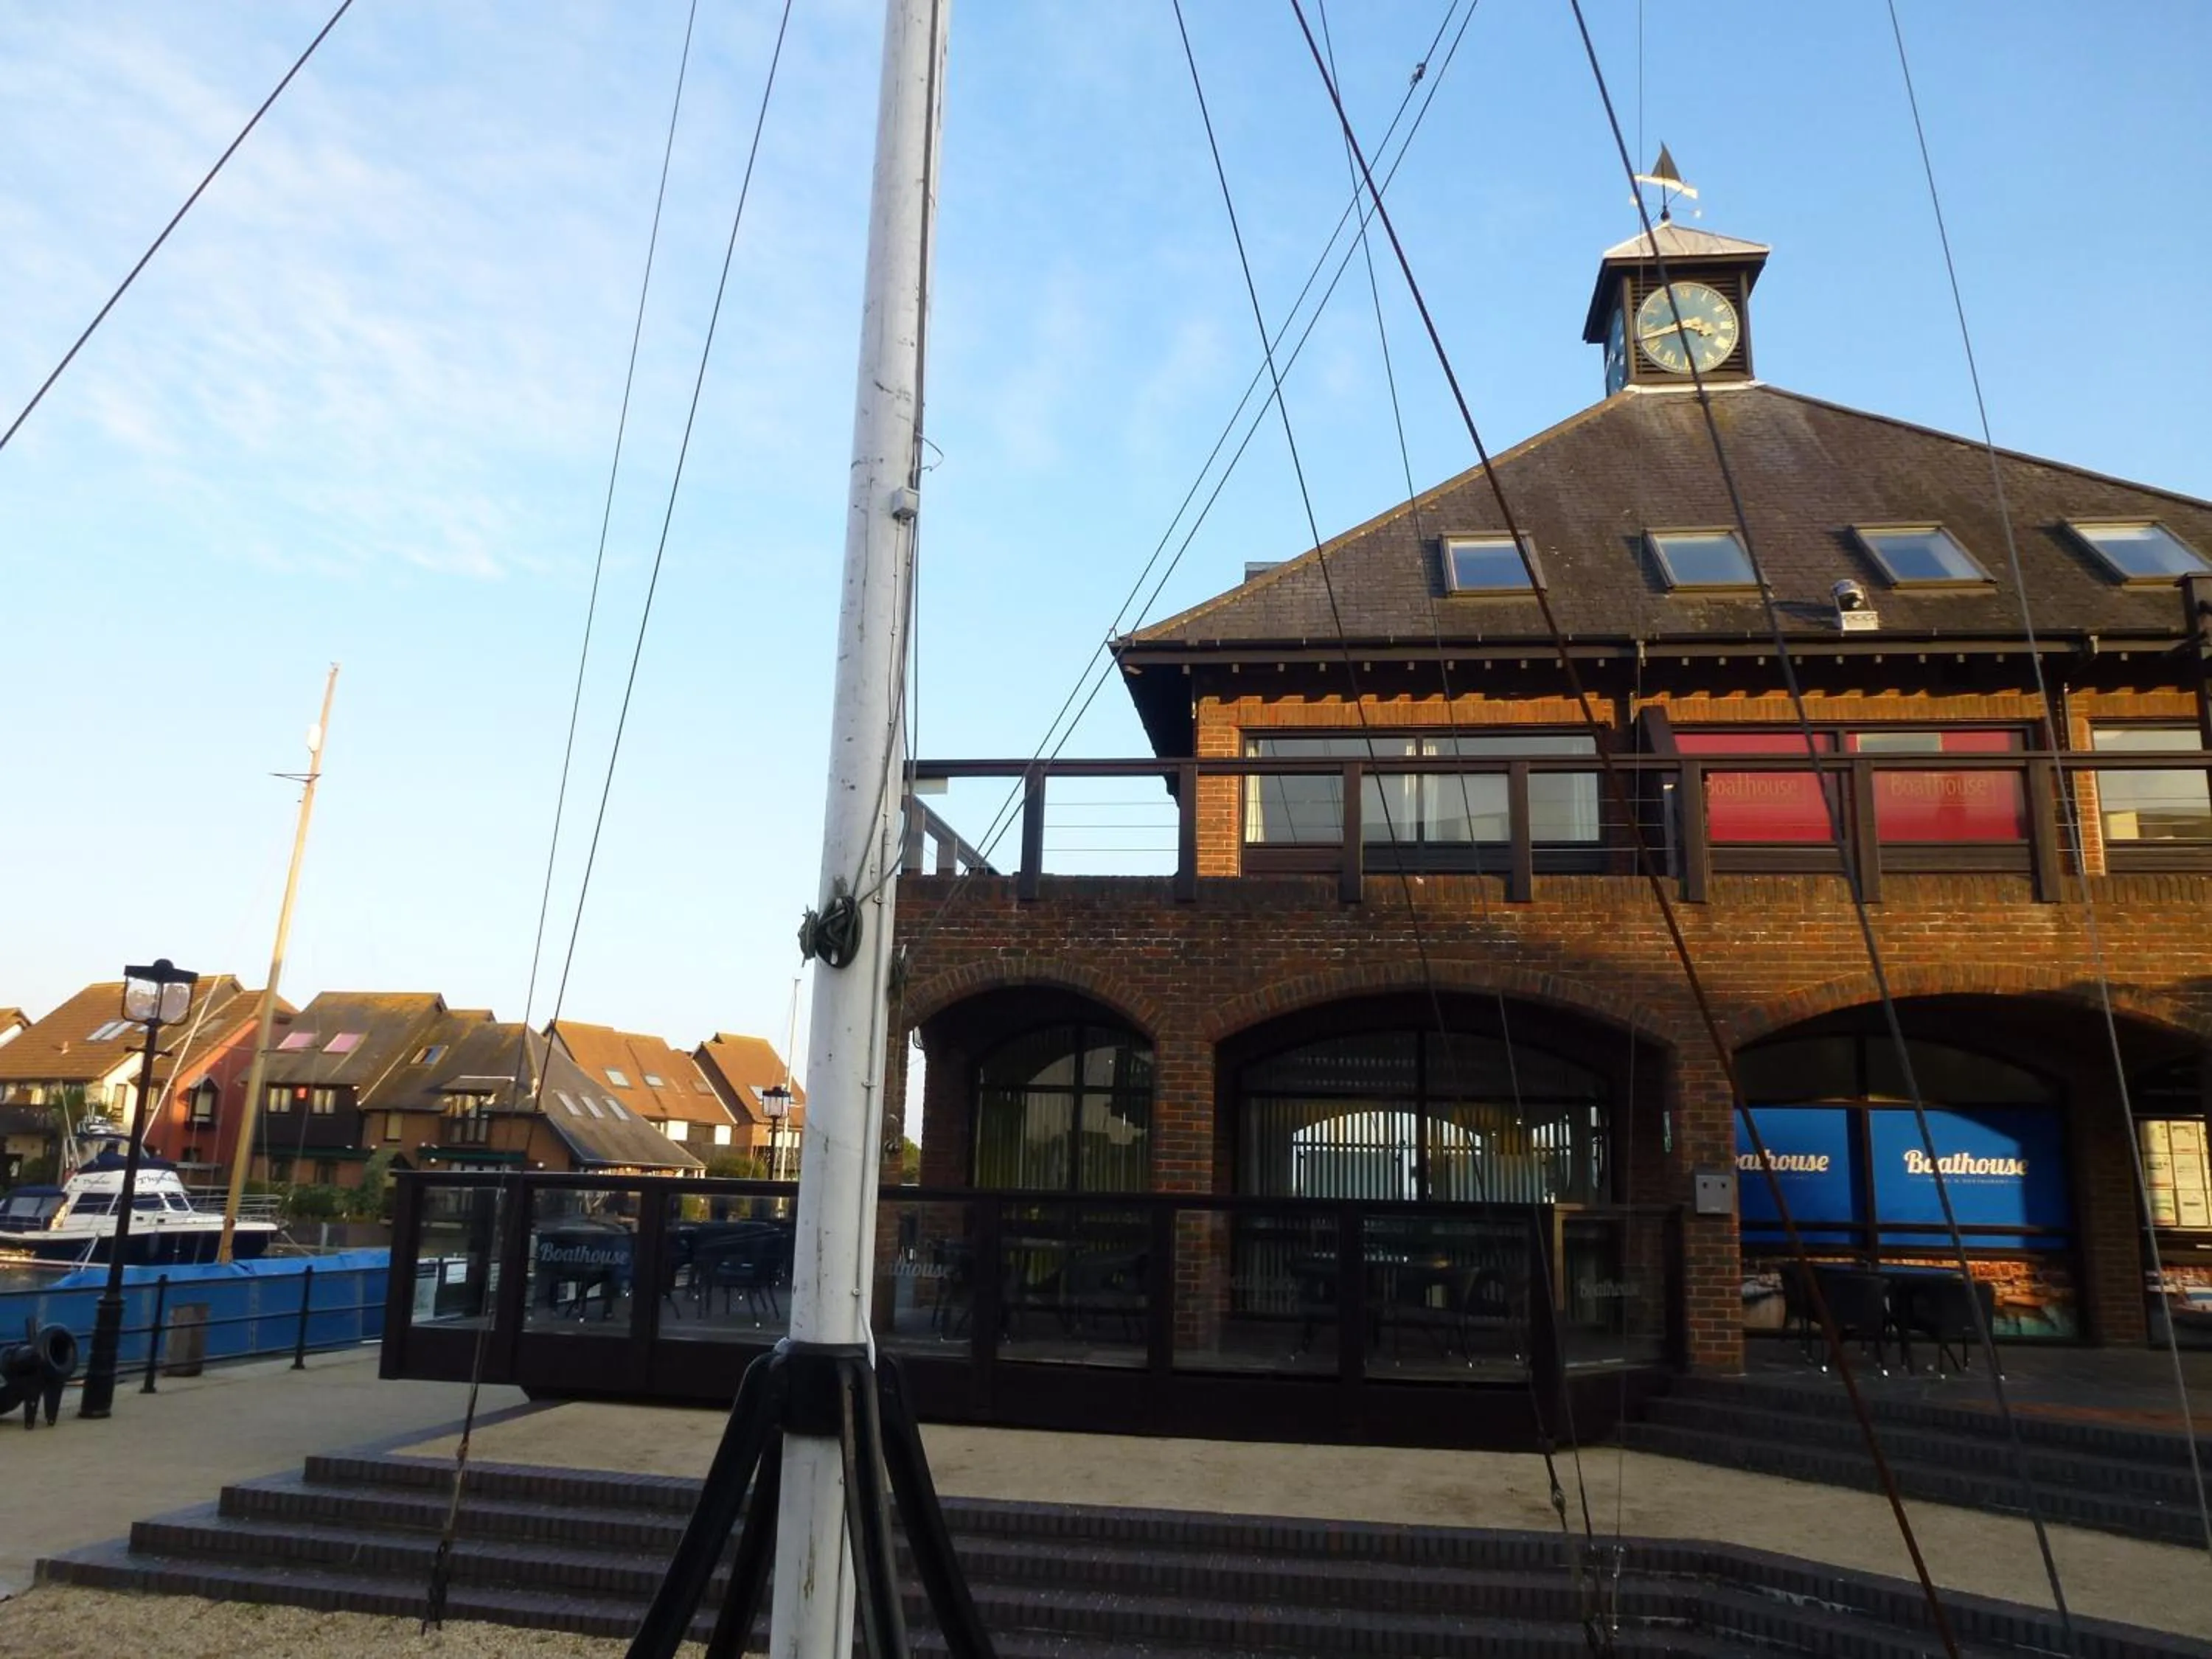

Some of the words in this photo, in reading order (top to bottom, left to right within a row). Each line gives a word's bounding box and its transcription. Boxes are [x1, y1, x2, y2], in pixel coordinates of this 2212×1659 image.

[1891, 773, 1986, 796] Boathouse
[1904, 1150, 2028, 1175] Boathouse
[540, 1242, 628, 1265] Boathouse
